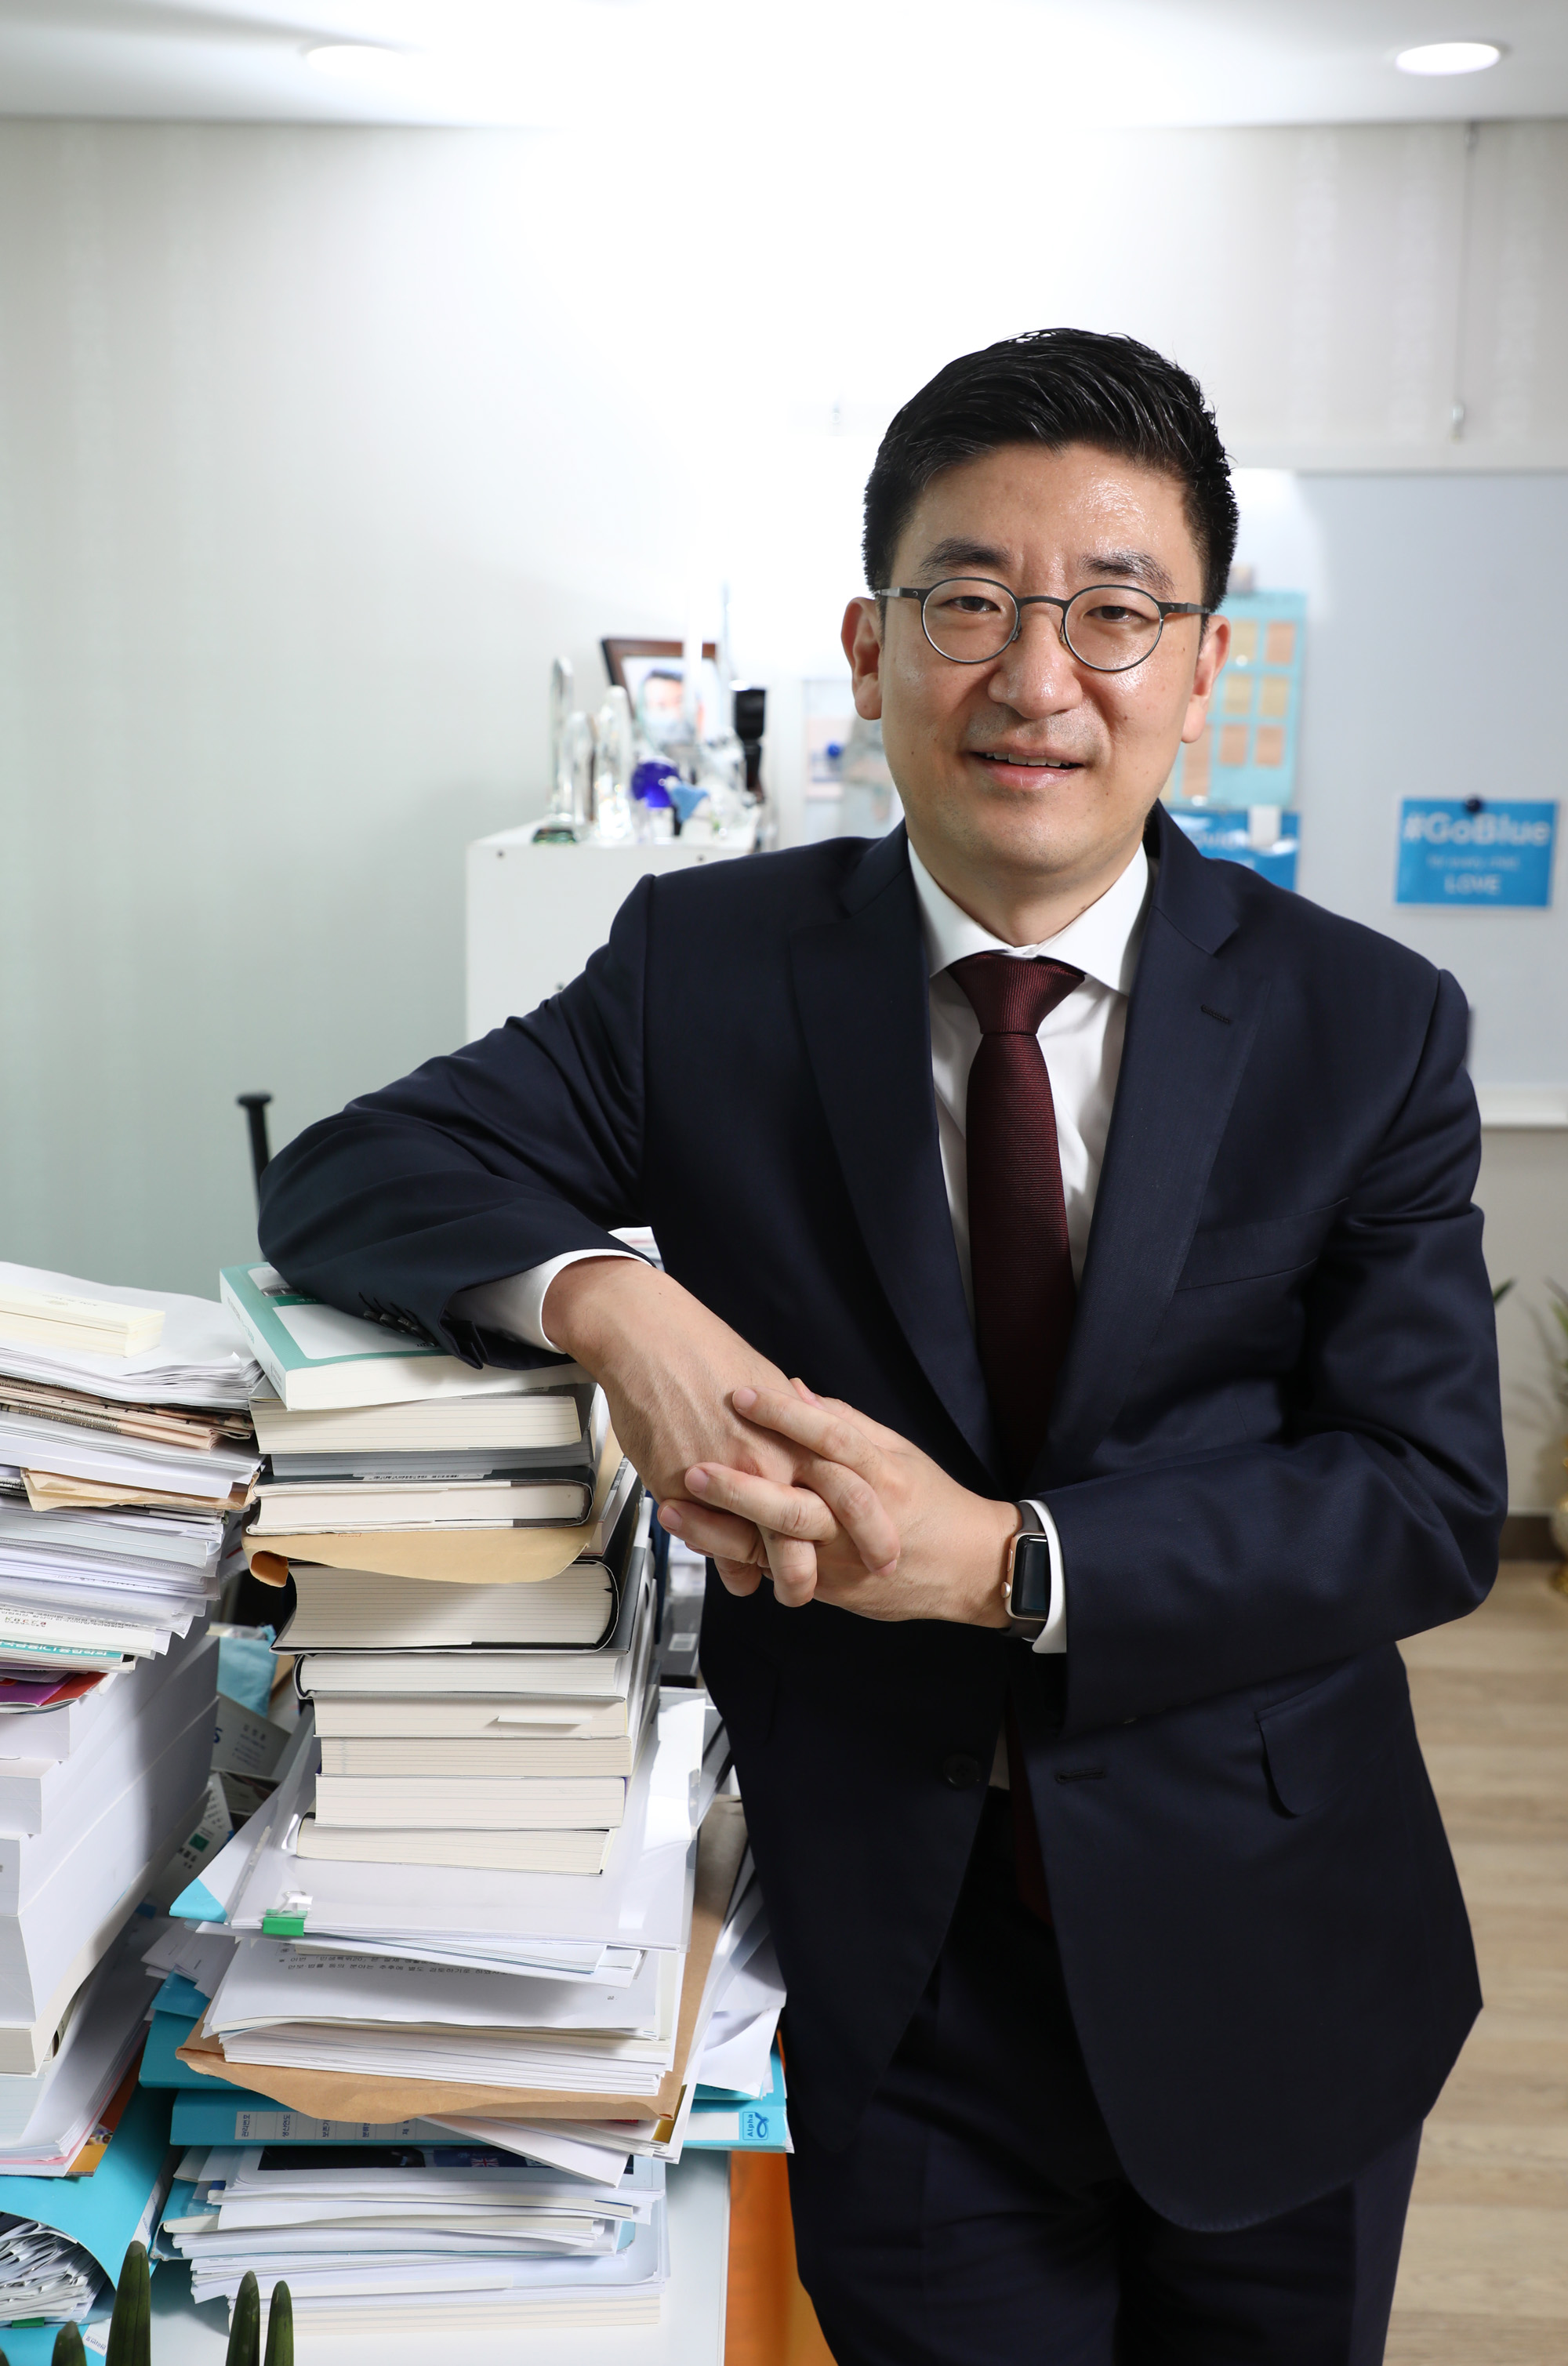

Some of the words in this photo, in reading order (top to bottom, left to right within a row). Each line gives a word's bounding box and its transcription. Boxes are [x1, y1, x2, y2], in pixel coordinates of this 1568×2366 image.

[1403, 811, 1552, 846] #GoBlue
[1444, 873, 1502, 895] LOVE
[29, 1411, 53, 1420] markets
[63, 1413, 92, 1421] Emmanuel
[60, 1417, 82, 1425] number
[93, 1419, 118, 1428] President
[92, 1424, 122, 1433] companies
[241, 2114, 250, 2137] 관리번호
[282, 2114, 291, 2138] 생산연도
